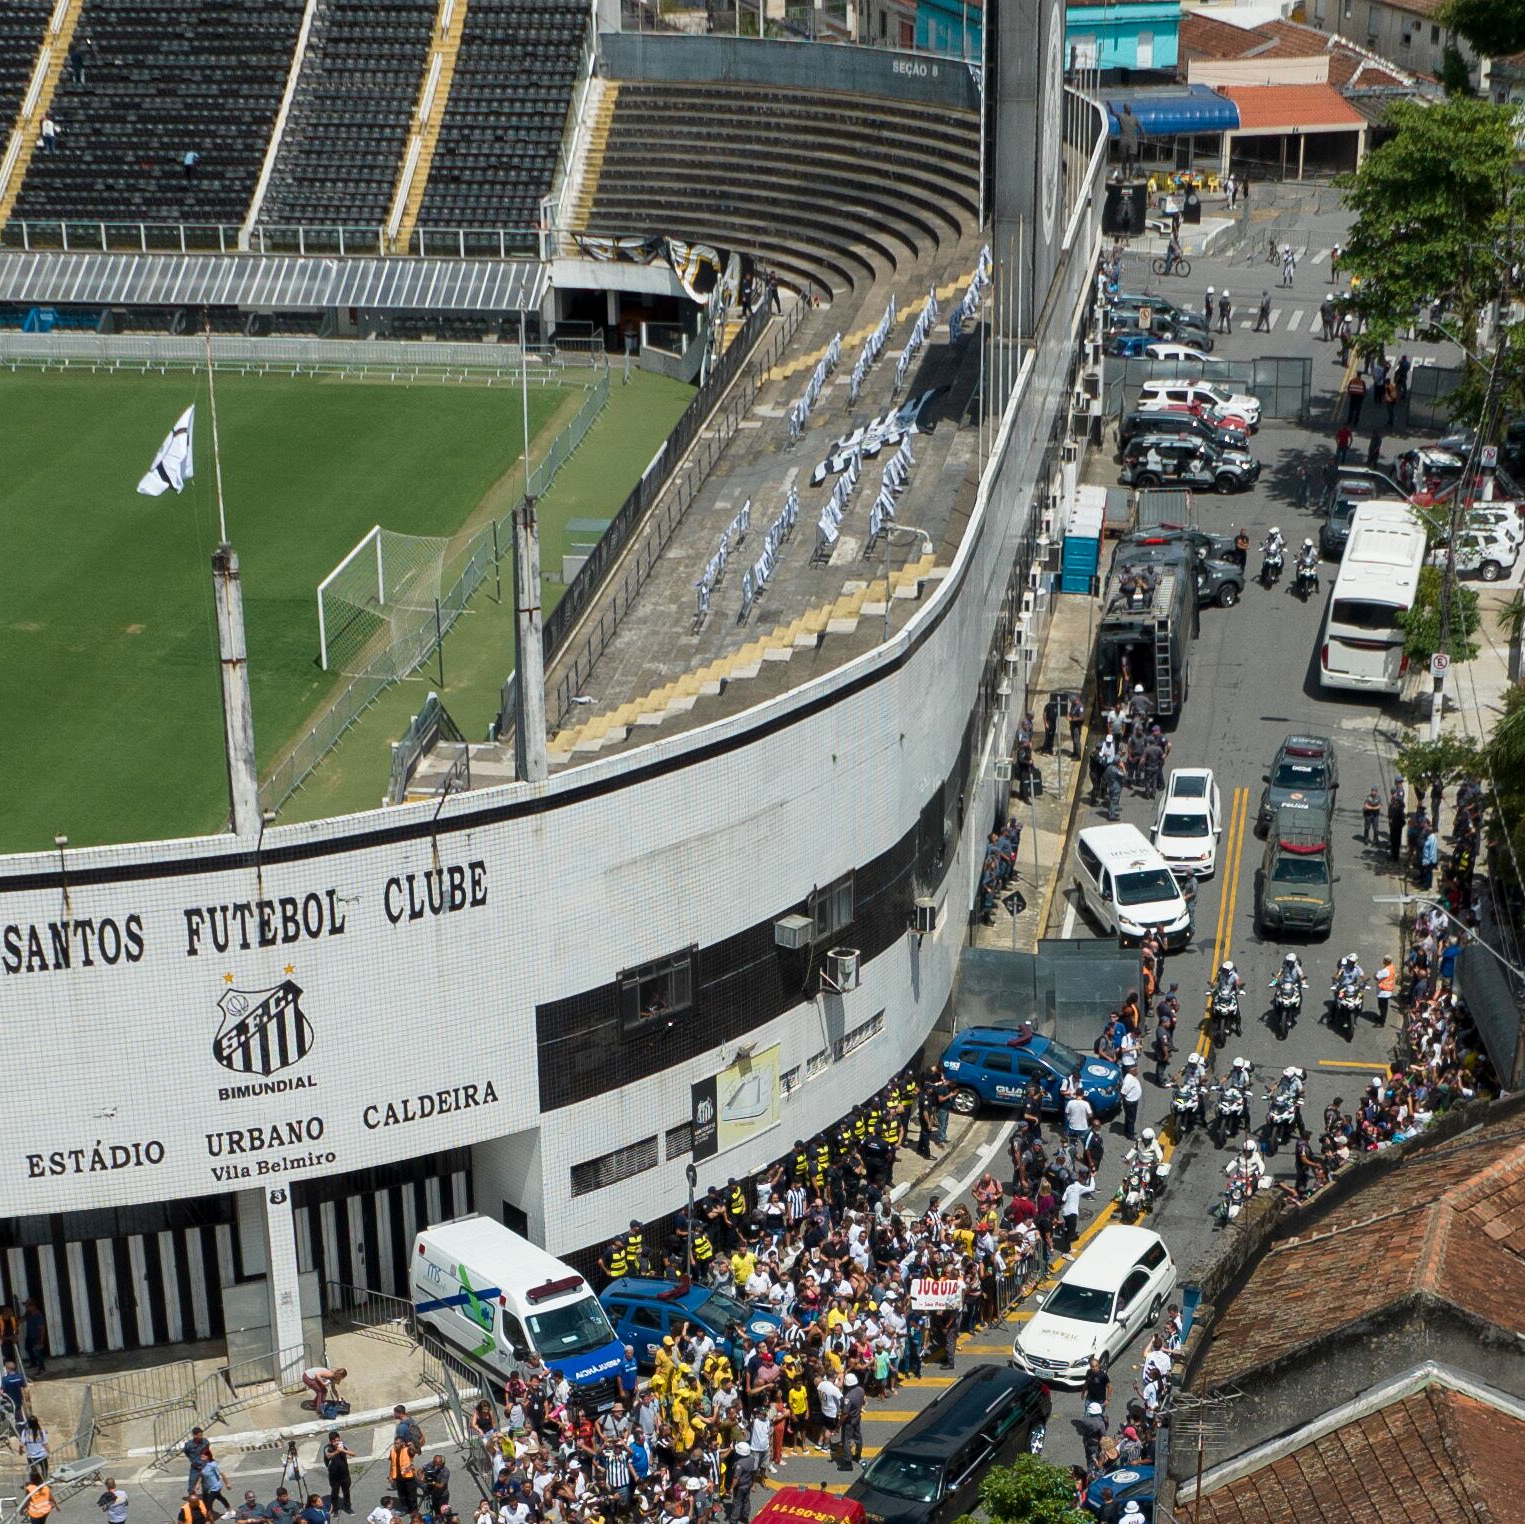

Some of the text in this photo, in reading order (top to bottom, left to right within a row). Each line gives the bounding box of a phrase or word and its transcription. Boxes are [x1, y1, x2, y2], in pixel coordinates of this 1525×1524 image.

[1, 859, 489, 976] SANTOS FUTEBOL CLUBE
[218, 1074, 318, 1101] BIMUNDIAL
[26, 1080, 499, 1178] ESTÁDIO URBANO CALDEIRA
[211, 1151, 337, 1182] Vila Belmiro
